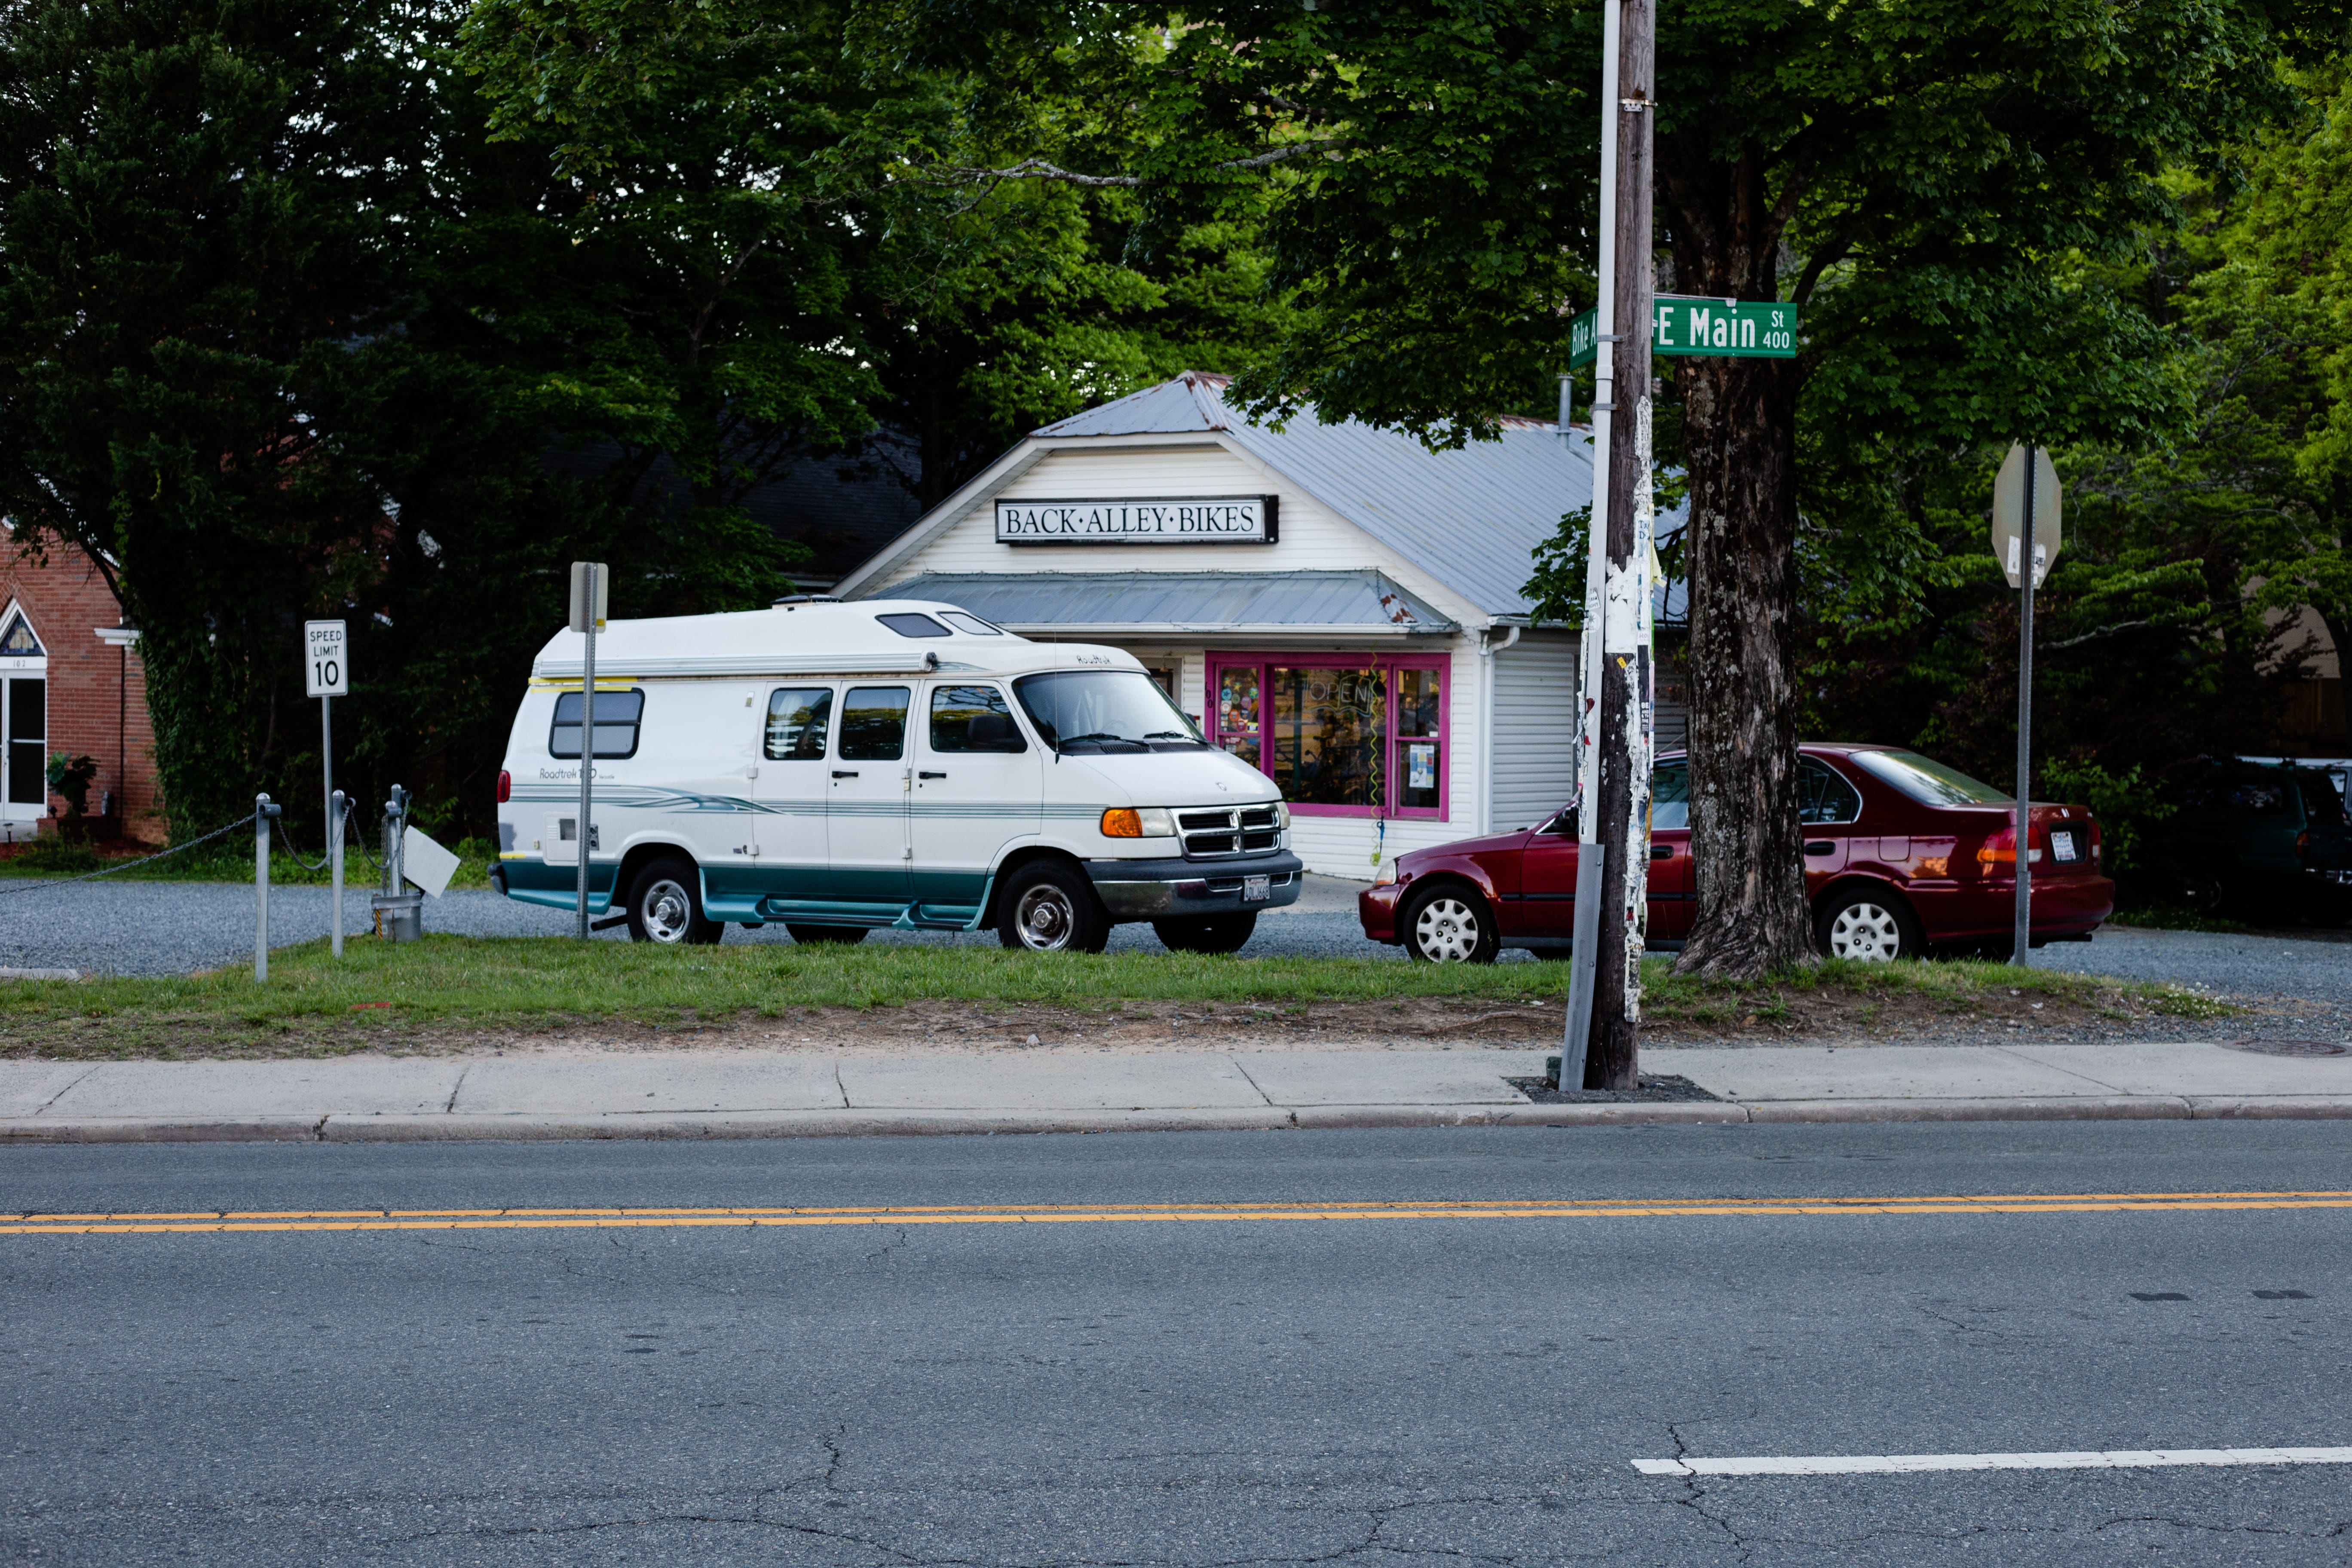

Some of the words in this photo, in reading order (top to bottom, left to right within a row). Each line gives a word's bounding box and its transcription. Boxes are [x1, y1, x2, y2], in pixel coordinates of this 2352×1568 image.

[1659, 306, 1674, 345] E
[1690, 307, 1755, 348] Main
[1771, 310, 1784, 328] St
[1572, 320, 1588, 356] Bike
[1763, 331, 1790, 349] 400
[1005, 509, 1078, 533] BACK
[1086, 508, 1168, 533] ALLEY
[1177, 506, 1254, 532] BIKES
[310, 631, 342, 642] SPEED
[314, 646, 338, 657] LIMIT
[1076, 654, 1112, 665] Roadtrek
[315, 660, 339, 687] 10
[1310, 681, 1367, 703] OPEN
[539, 768, 577, 779] Roadtrek
